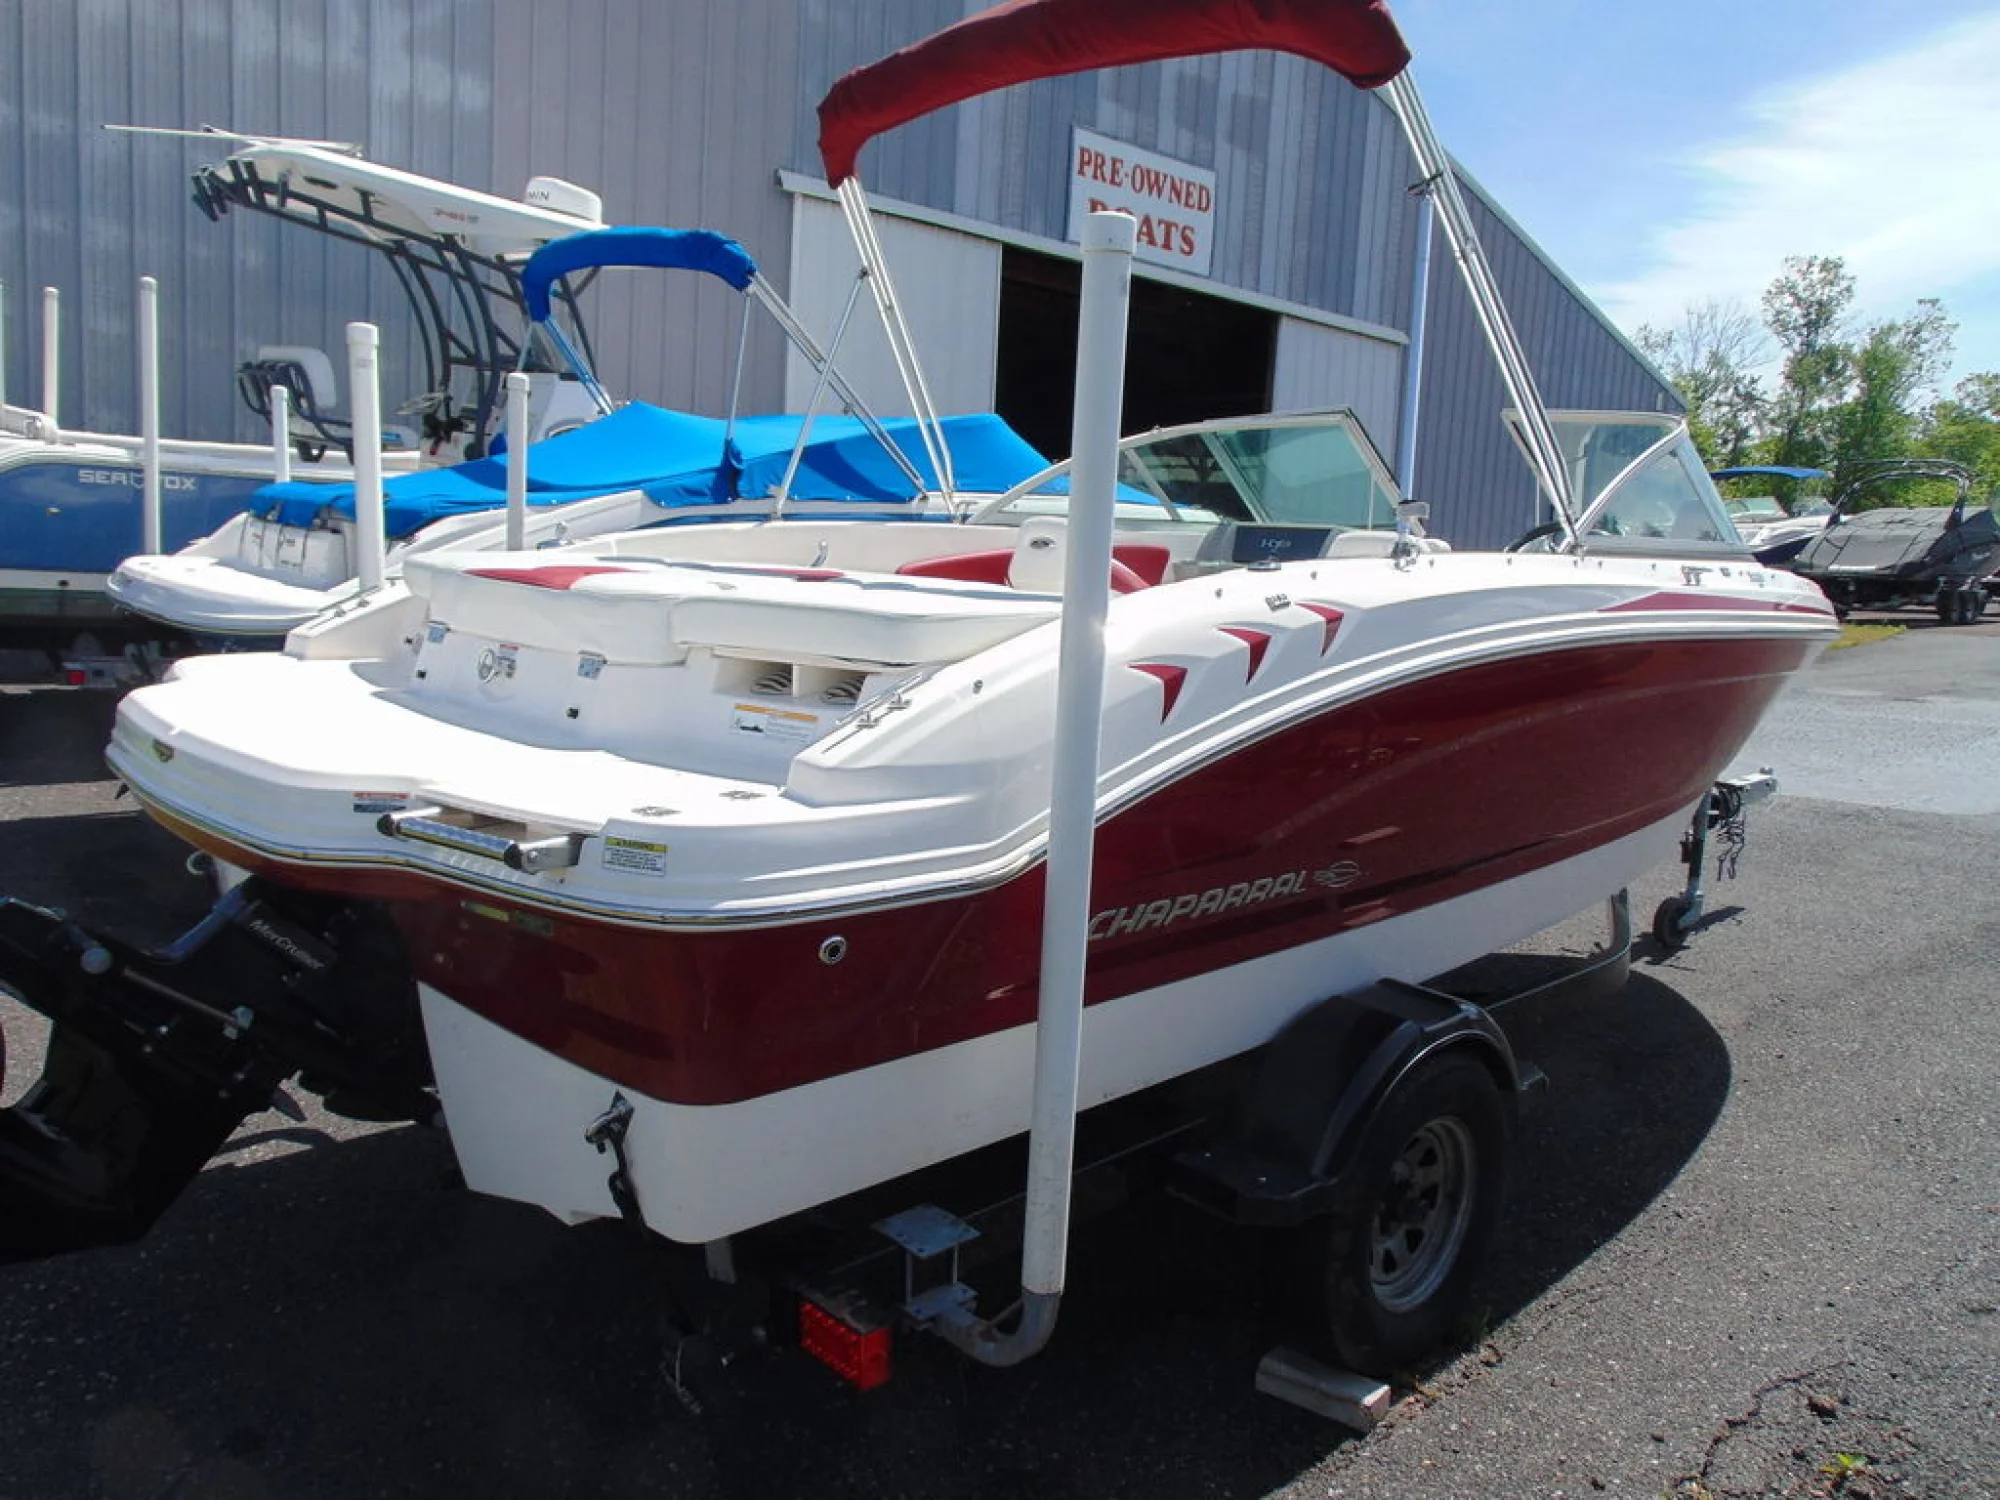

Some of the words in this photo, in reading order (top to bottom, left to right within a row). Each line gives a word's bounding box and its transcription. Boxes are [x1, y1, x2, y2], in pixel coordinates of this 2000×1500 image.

[1077, 146, 1211, 213] PRE-OWNED
[1088, 197, 1196, 257] ATS
[1088, 870, 1308, 939] CHAPARRAL
